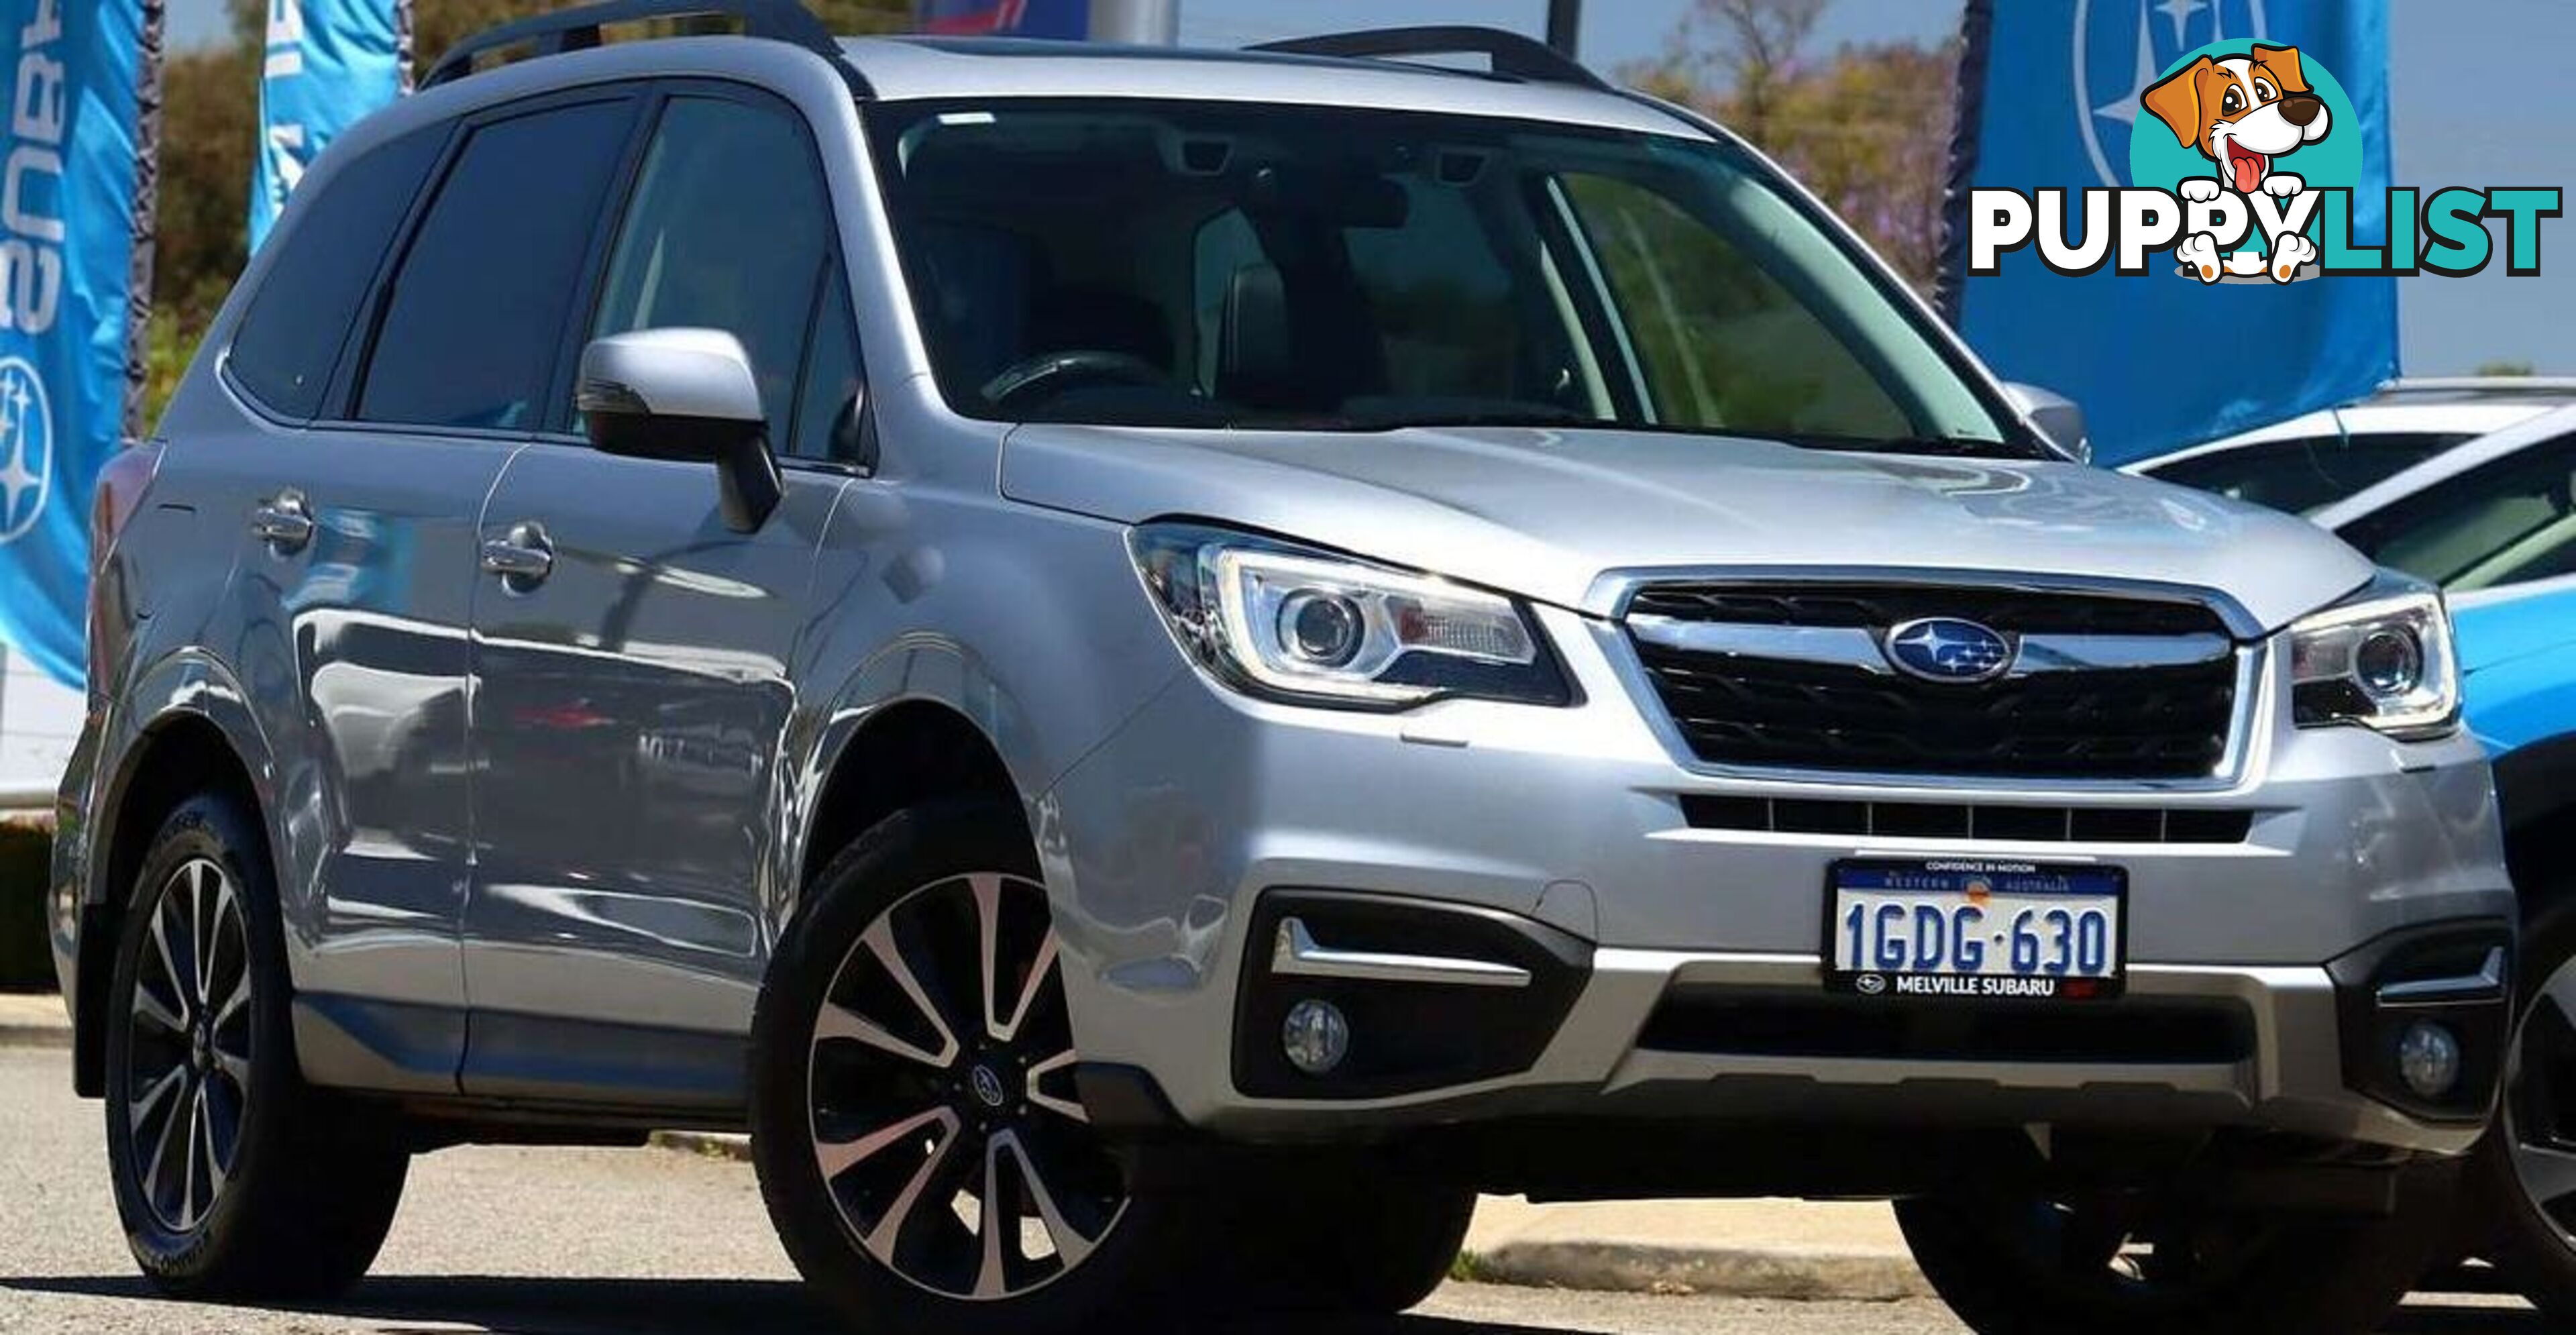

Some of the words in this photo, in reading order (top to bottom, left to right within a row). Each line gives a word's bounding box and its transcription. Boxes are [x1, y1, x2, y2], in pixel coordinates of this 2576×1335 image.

[1926, 861, 1984, 871] CONFIDENCE
[1986, 862, 1995, 871] IN
[1998, 862, 2036, 873] MOTION
[1896, 975, 1978, 994] MELVILLE
[1982, 977, 2055, 996] SUBARU
